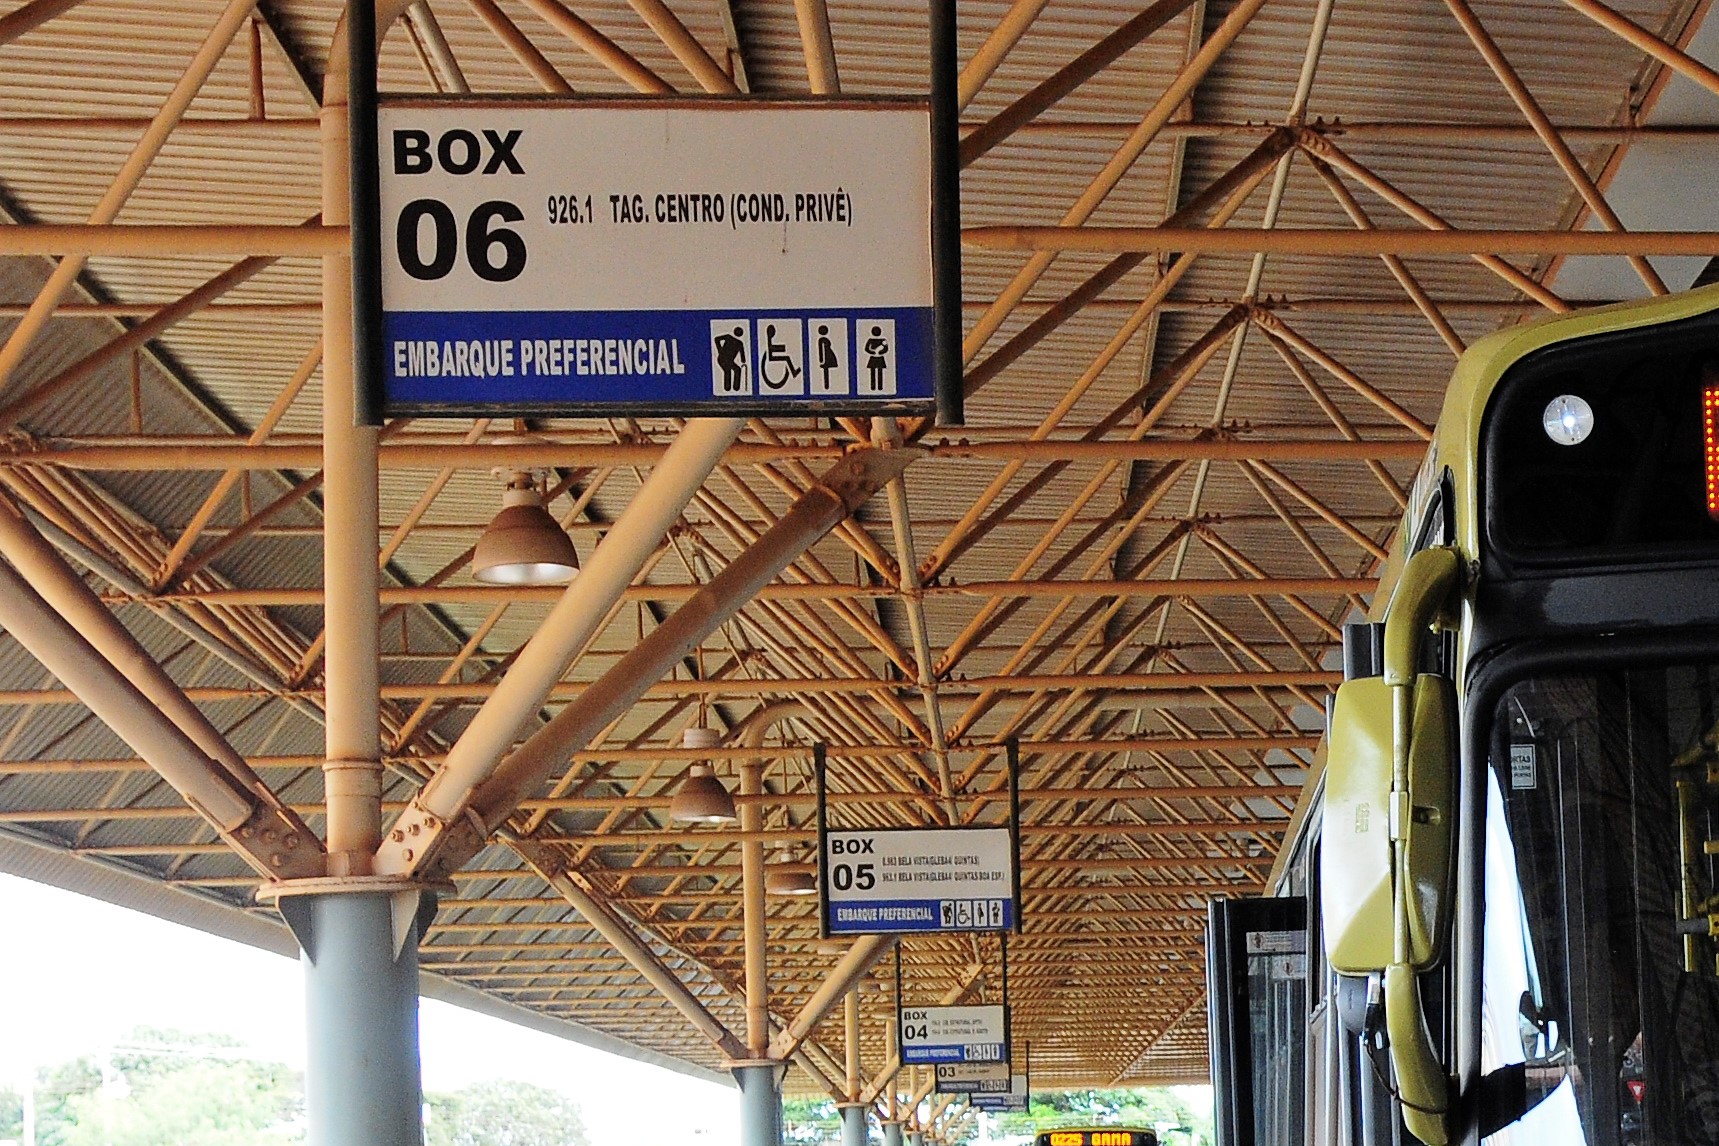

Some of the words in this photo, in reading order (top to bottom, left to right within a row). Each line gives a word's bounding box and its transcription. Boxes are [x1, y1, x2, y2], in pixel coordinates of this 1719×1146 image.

[393, 130, 525, 175] BOX
[547, 195, 593, 224] 926.1
[610, 195, 649, 224] TAG.
[655, 194, 724, 223] CENTRO
[730, 193, 789, 230] (COND.
[795, 187, 852, 227] PRIVÊ)
[396, 199, 527, 281] 06
[393, 340, 514, 378] EMBARQUE
[521, 338, 684, 375] PREFERENCIAL
[831, 838, 874, 855] BOX
[833, 864, 875, 890] 05
[879, 907, 933, 920] PREFERENCIAL
[904, 1012, 927, 1020] BOX
[905, 1025, 928, 1039] 04
[939, 1067, 955, 1077] 03
[1091, 1132, 1131, 1146] GAMA
